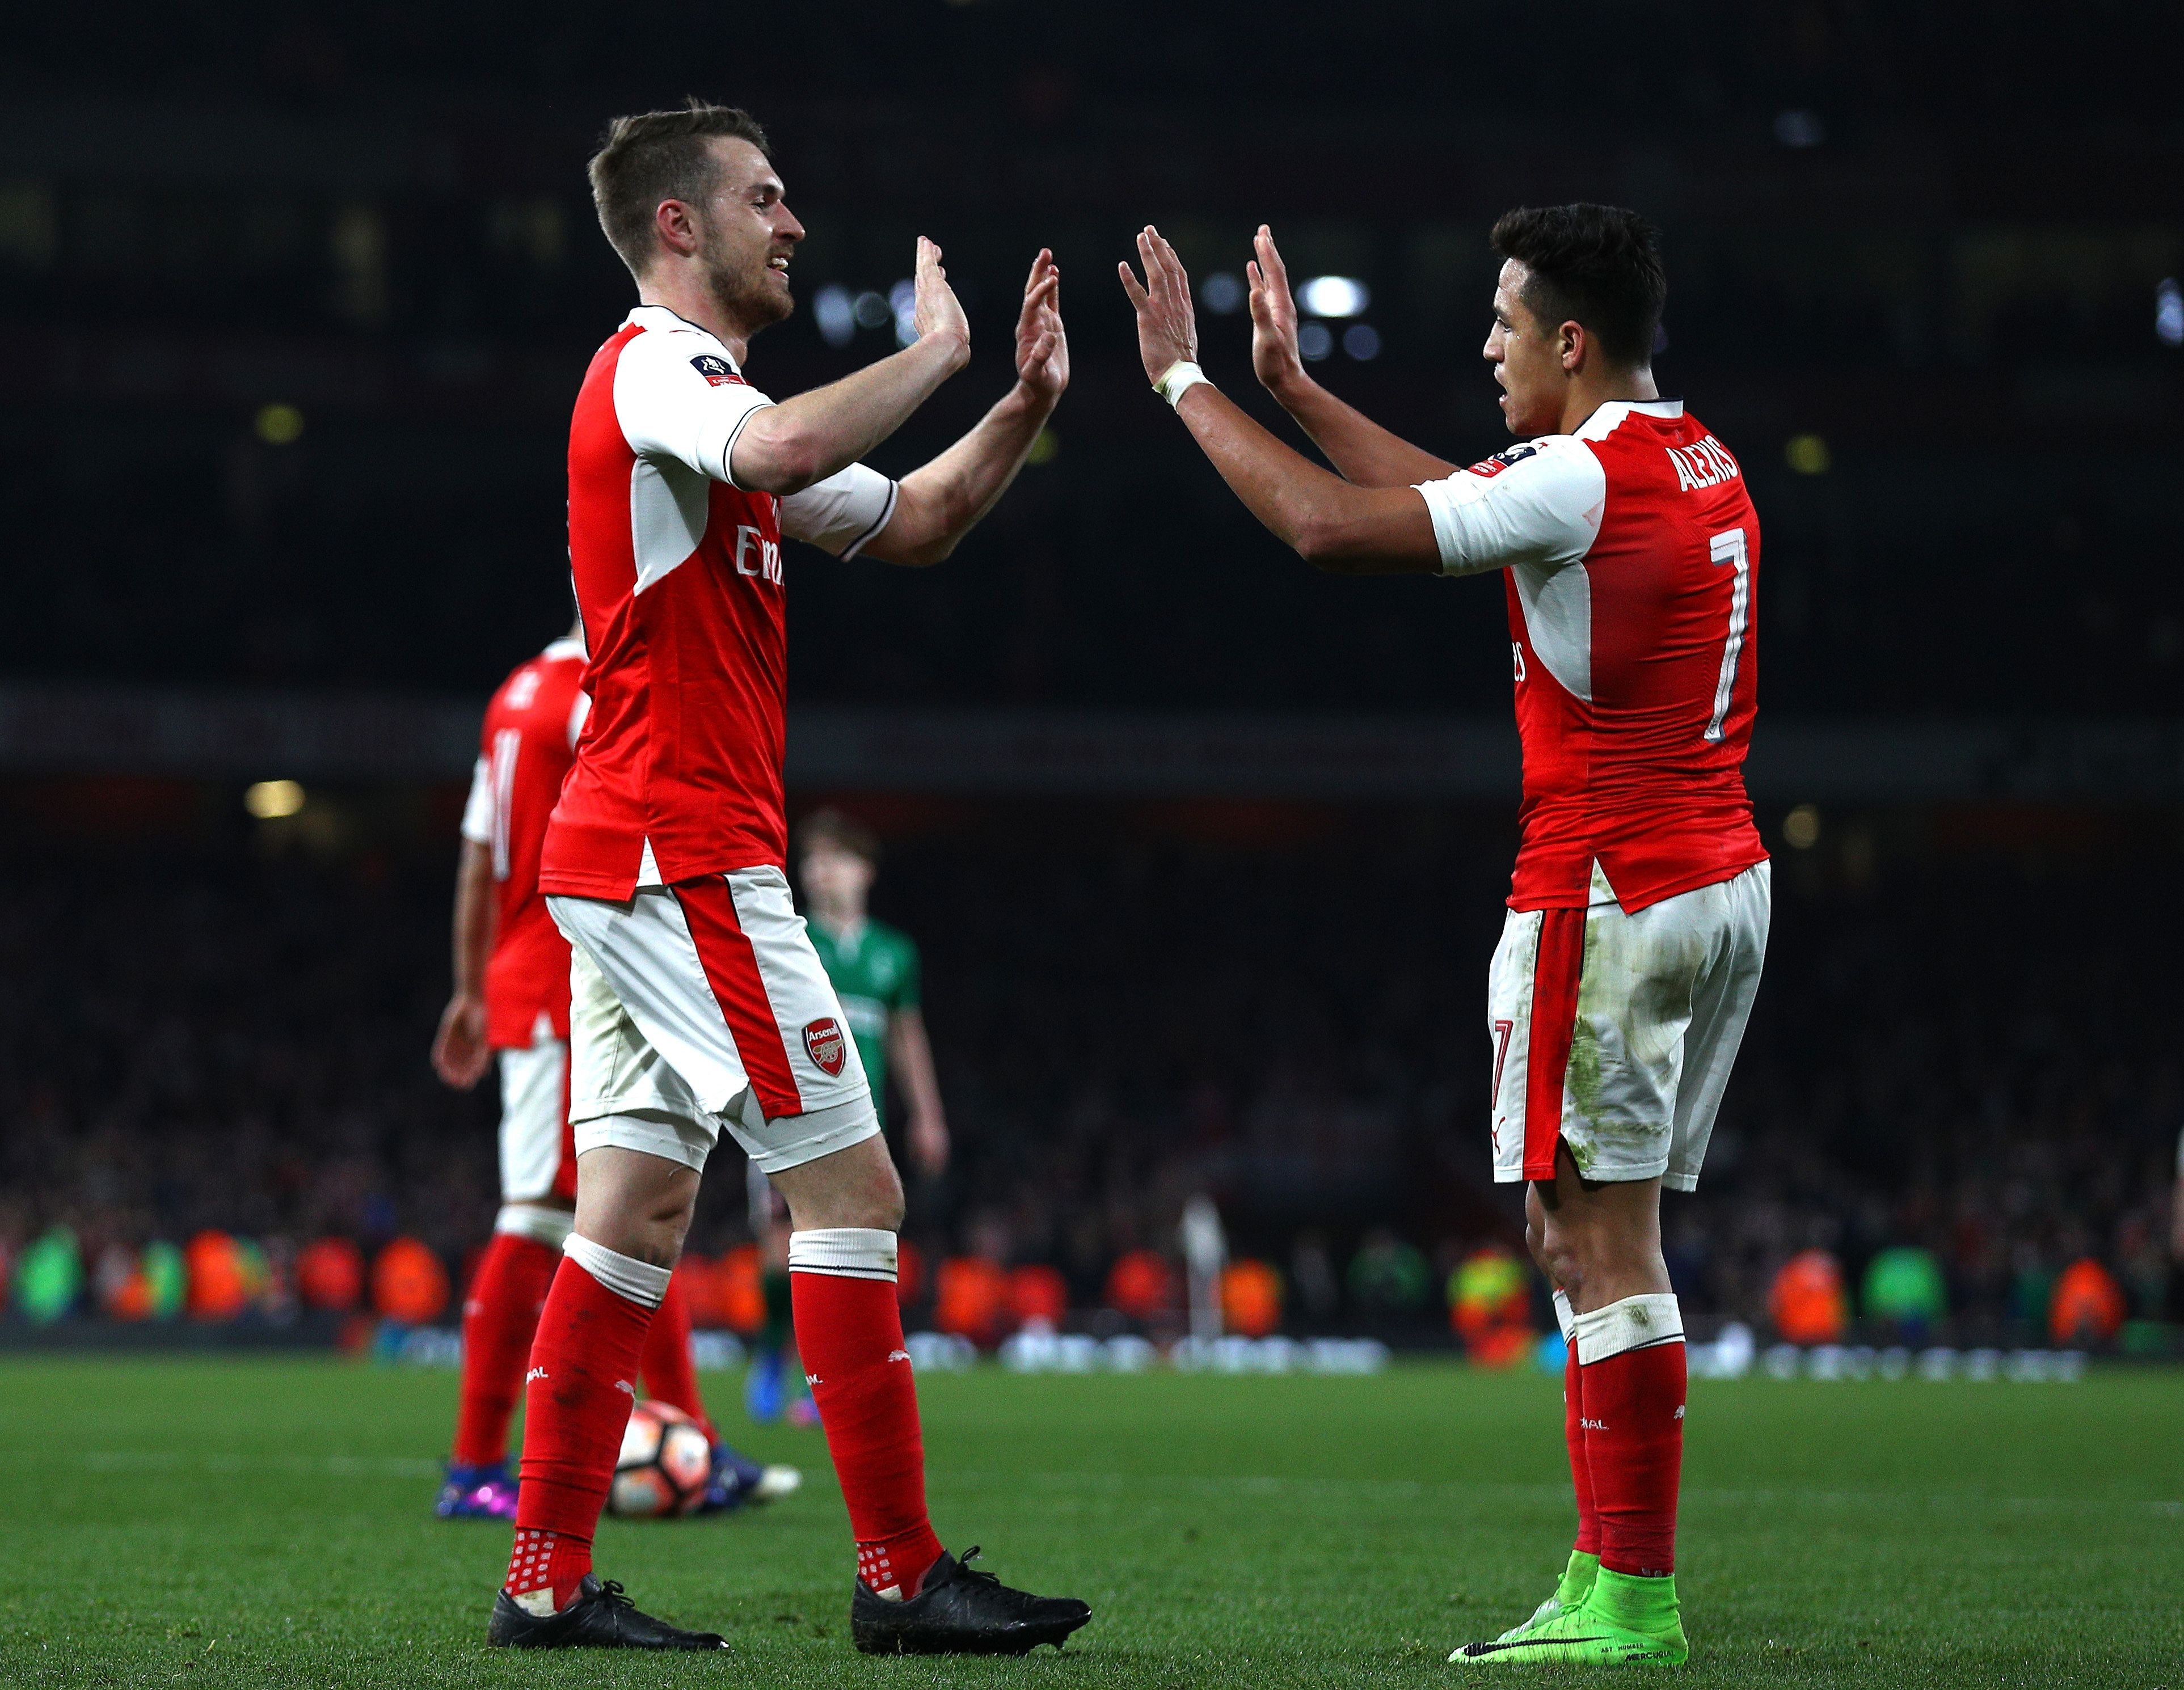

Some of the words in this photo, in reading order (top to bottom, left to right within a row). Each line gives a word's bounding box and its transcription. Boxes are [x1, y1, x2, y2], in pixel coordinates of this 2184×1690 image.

[1665, 434, 1738, 492] ALEXIS
[736, 525, 785, 586] Em
[1704, 527, 1749, 743] 7
[1492, 1019, 1514, 1110] 7
